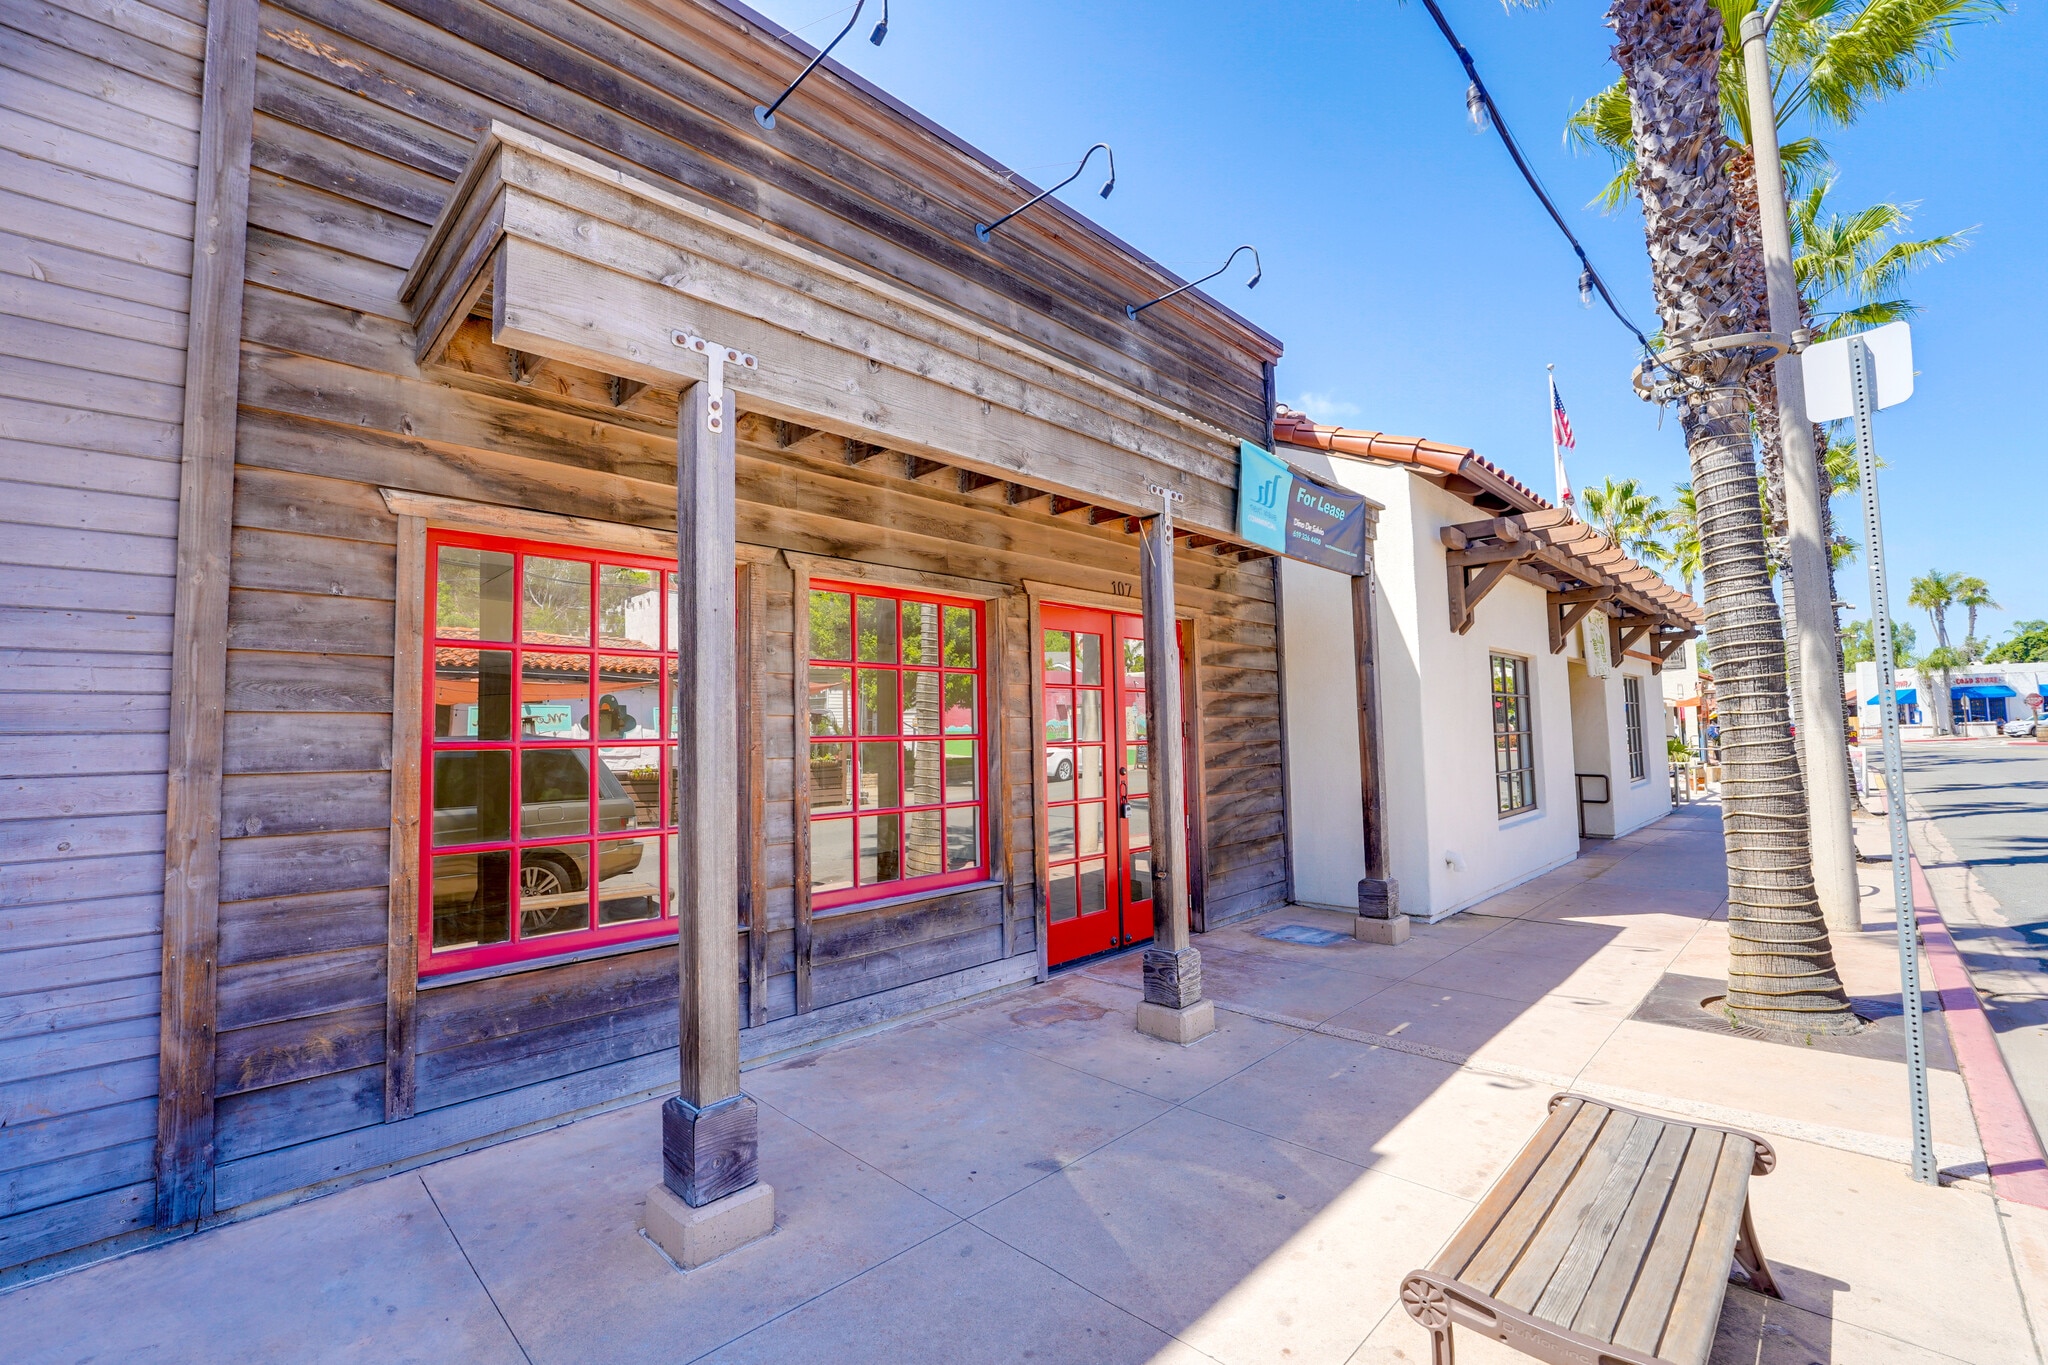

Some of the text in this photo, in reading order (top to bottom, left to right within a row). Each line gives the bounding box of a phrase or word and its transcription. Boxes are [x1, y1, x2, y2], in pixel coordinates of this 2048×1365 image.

[1296, 487, 1346, 521] For Lease
[1111, 580, 1132, 597] 107
